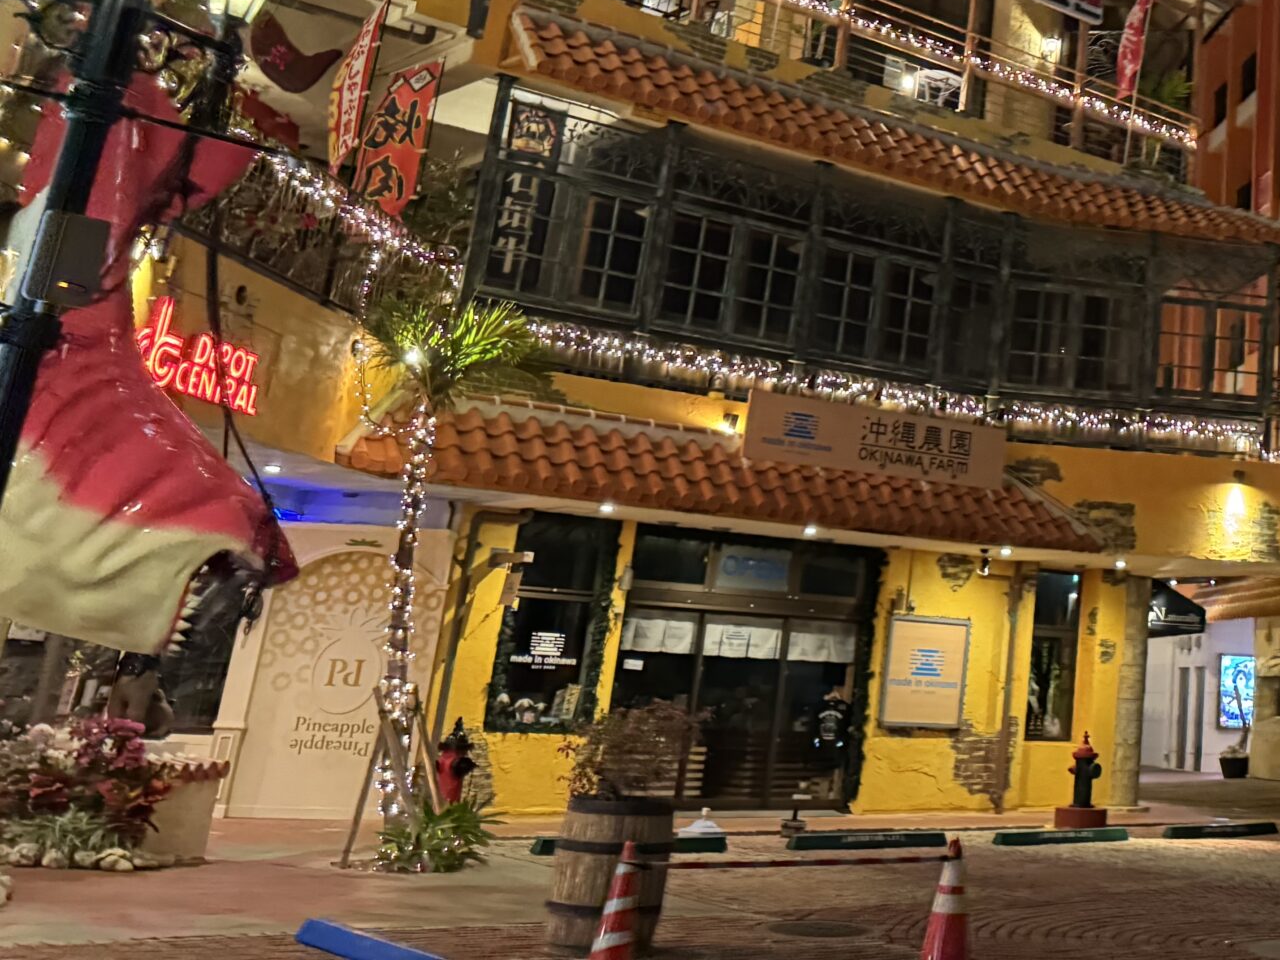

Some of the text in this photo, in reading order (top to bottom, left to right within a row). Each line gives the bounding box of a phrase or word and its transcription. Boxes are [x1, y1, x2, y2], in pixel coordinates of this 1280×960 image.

[363, 96, 422, 201] 焼肉
[861, 416, 973, 457] 沖縄農園
[858, 448, 928, 475] OKINAWA
[509, 654, 533, 664] made
[534, 654, 542, 664] in
[294, 716, 375, 738] Pineapple
